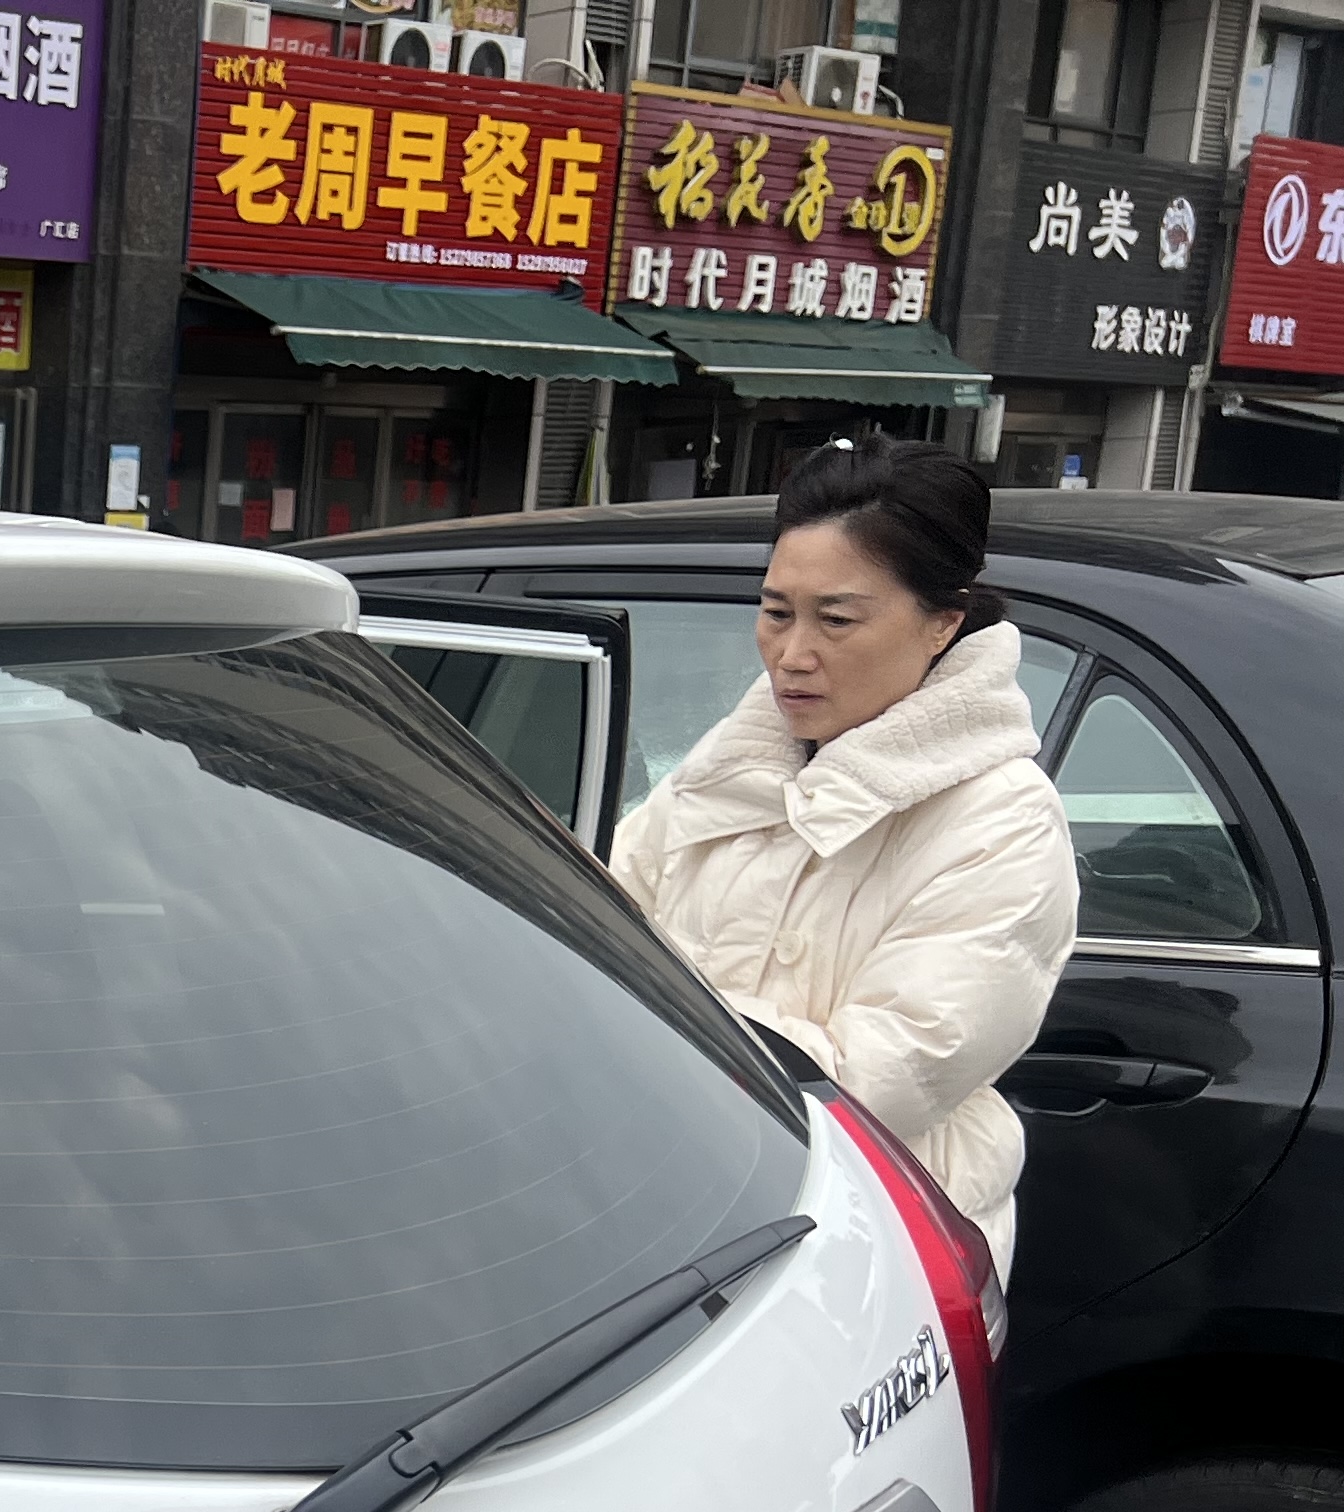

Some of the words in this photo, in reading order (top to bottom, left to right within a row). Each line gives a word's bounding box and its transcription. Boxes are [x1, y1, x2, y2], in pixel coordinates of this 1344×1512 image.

[216, 91, 603, 249] 老周早餐店
[1028, 181, 1140, 261] 尚美
[626, 245, 928, 324] 时代月城烟酒
[1091, 304, 1192, 357] 形象设计
